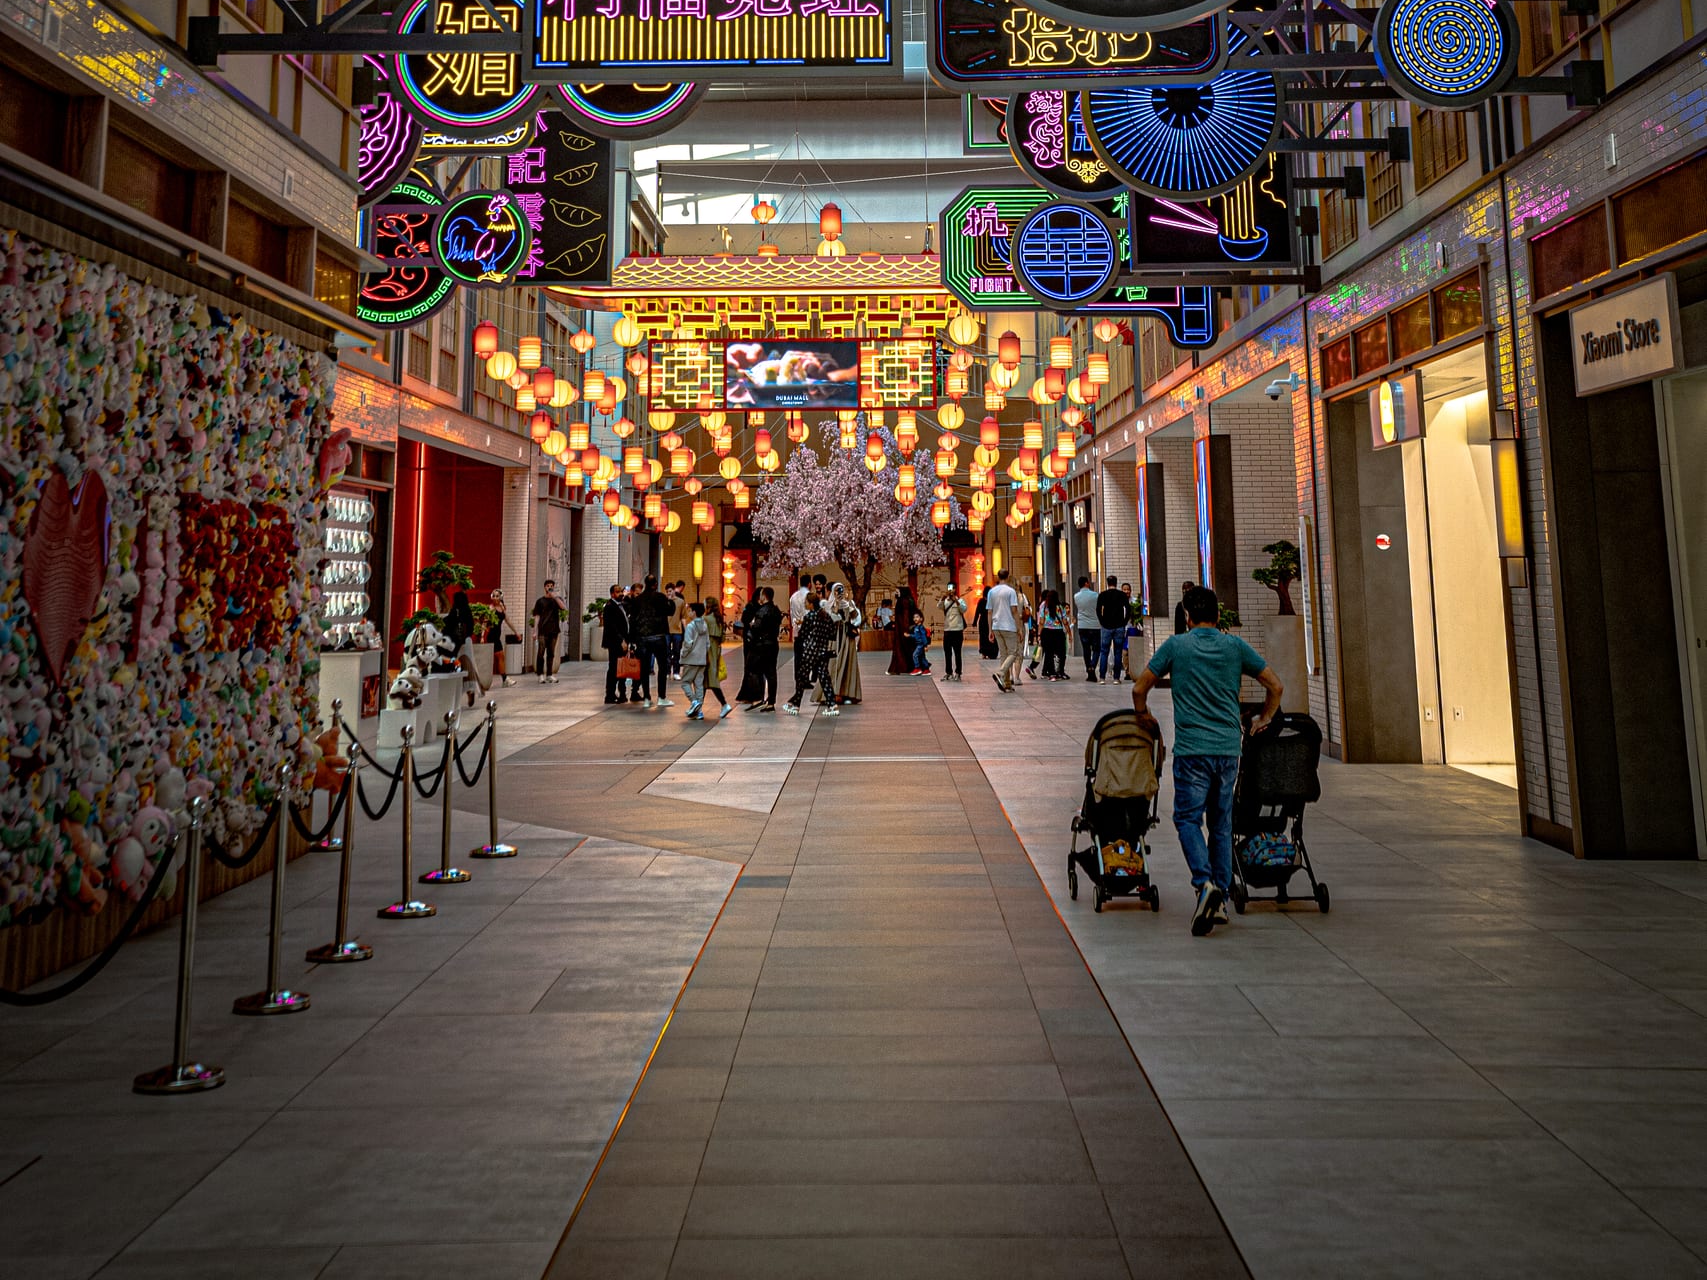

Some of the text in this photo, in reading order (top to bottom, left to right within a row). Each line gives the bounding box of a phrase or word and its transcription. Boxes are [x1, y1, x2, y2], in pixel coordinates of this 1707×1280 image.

[968, 276, 1014, 294] FIGHT
[1581, 318, 1661, 366] Xiaomi Store
